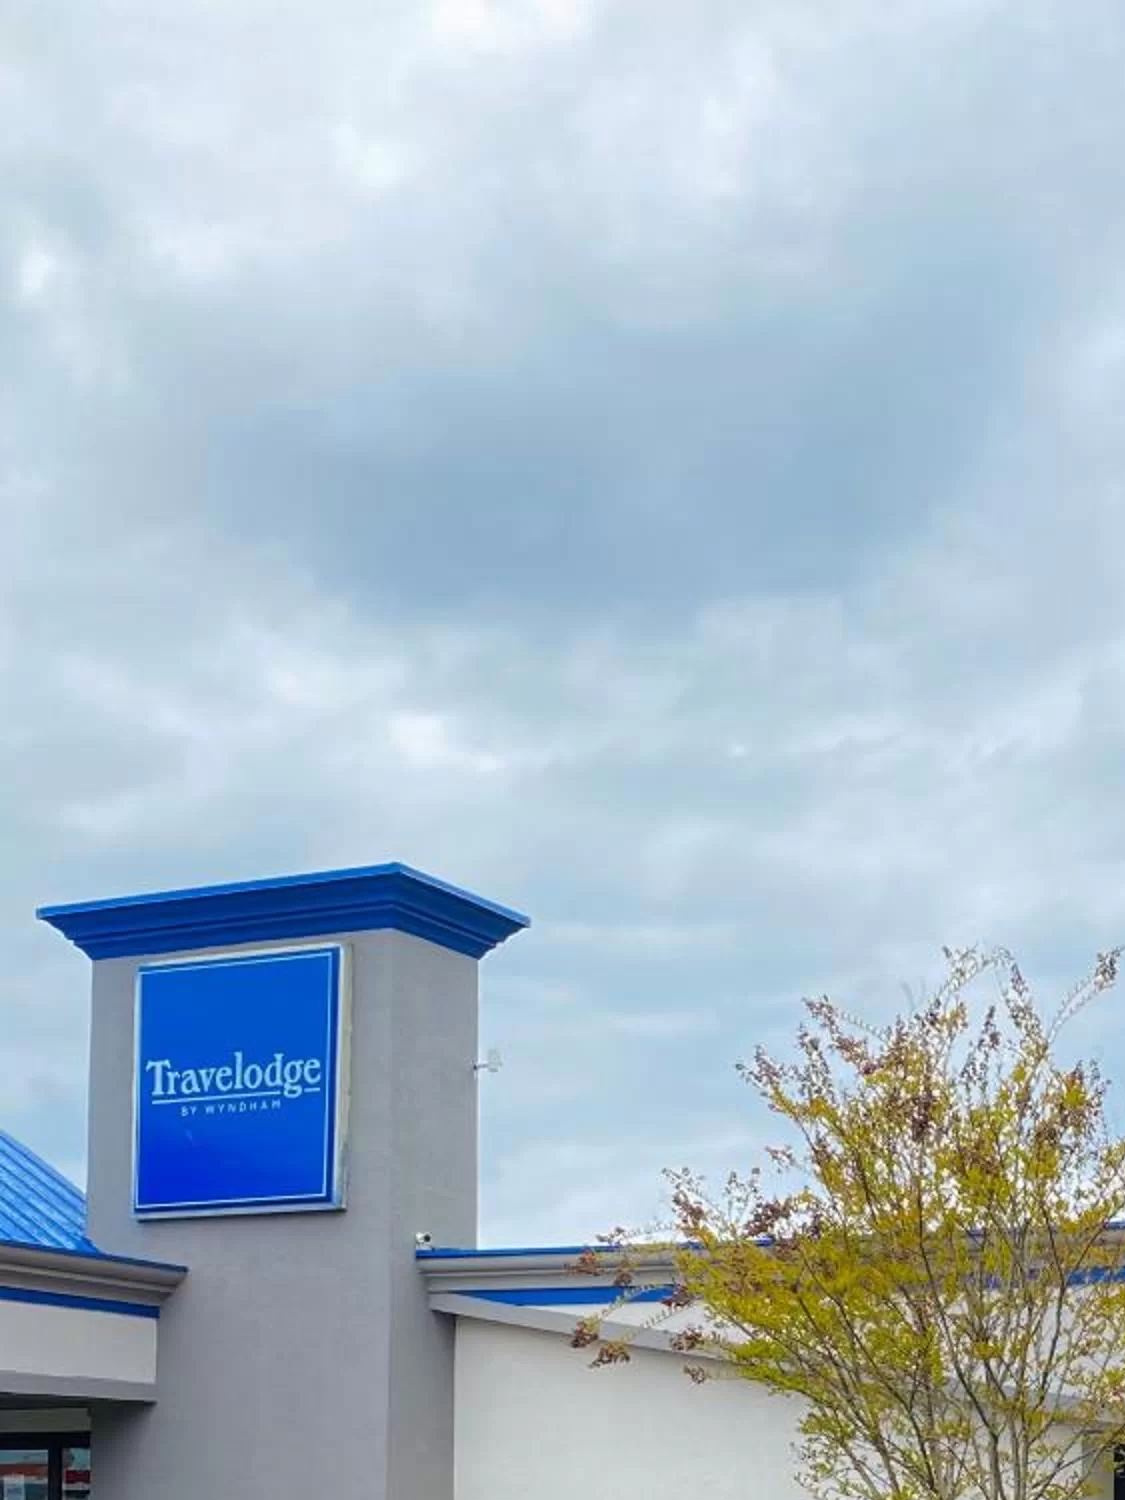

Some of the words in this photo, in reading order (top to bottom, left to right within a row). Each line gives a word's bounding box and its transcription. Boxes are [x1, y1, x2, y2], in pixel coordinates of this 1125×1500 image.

[145, 1051, 321, 1098] Travelodge
[180, 1106, 197, 1117] BY
[205, 1099, 281, 1115] WYNDHAM
